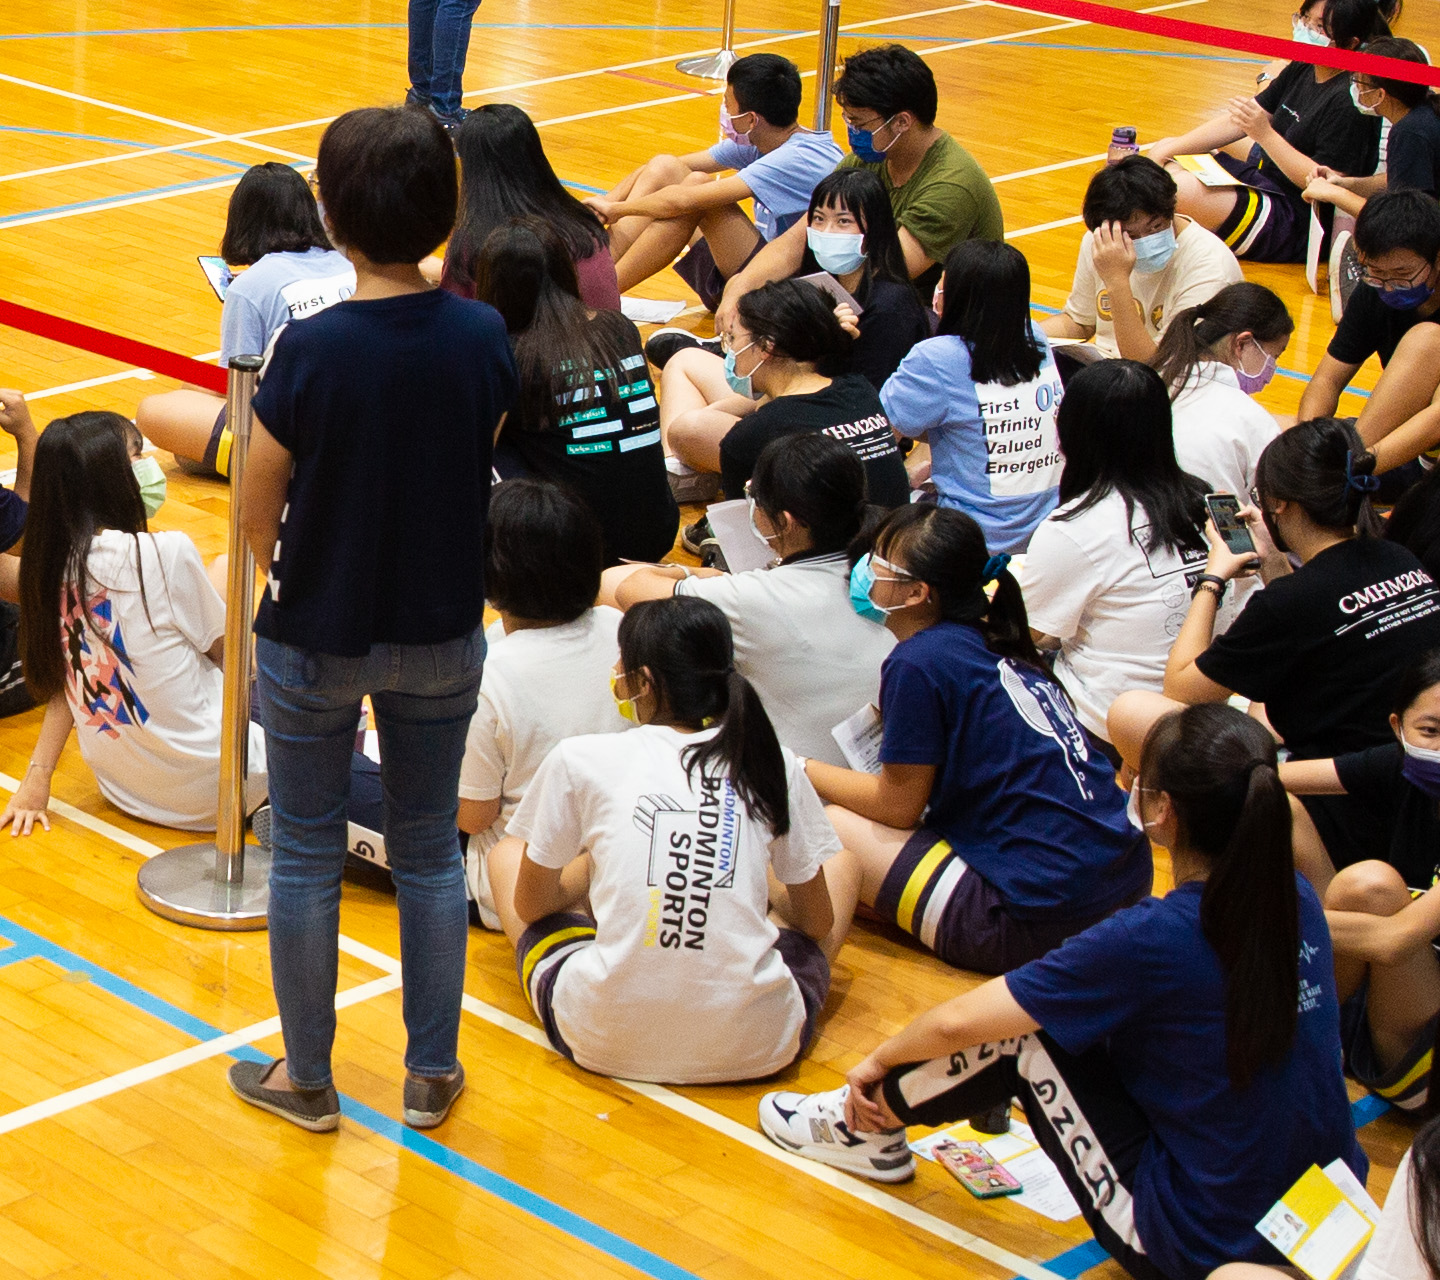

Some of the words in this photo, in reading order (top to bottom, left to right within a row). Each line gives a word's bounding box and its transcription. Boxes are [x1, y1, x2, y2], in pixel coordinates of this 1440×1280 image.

[288, 295, 326, 318] First
[978, 398, 1019, 417] First
[982, 416, 1042, 436] Infinity
[984, 435, 1042, 455] Valued
[985, 452, 1060, 475] Energetic
[684, 776, 720, 950] BADMINTON
[659, 832, 691, 950] SPORTS
